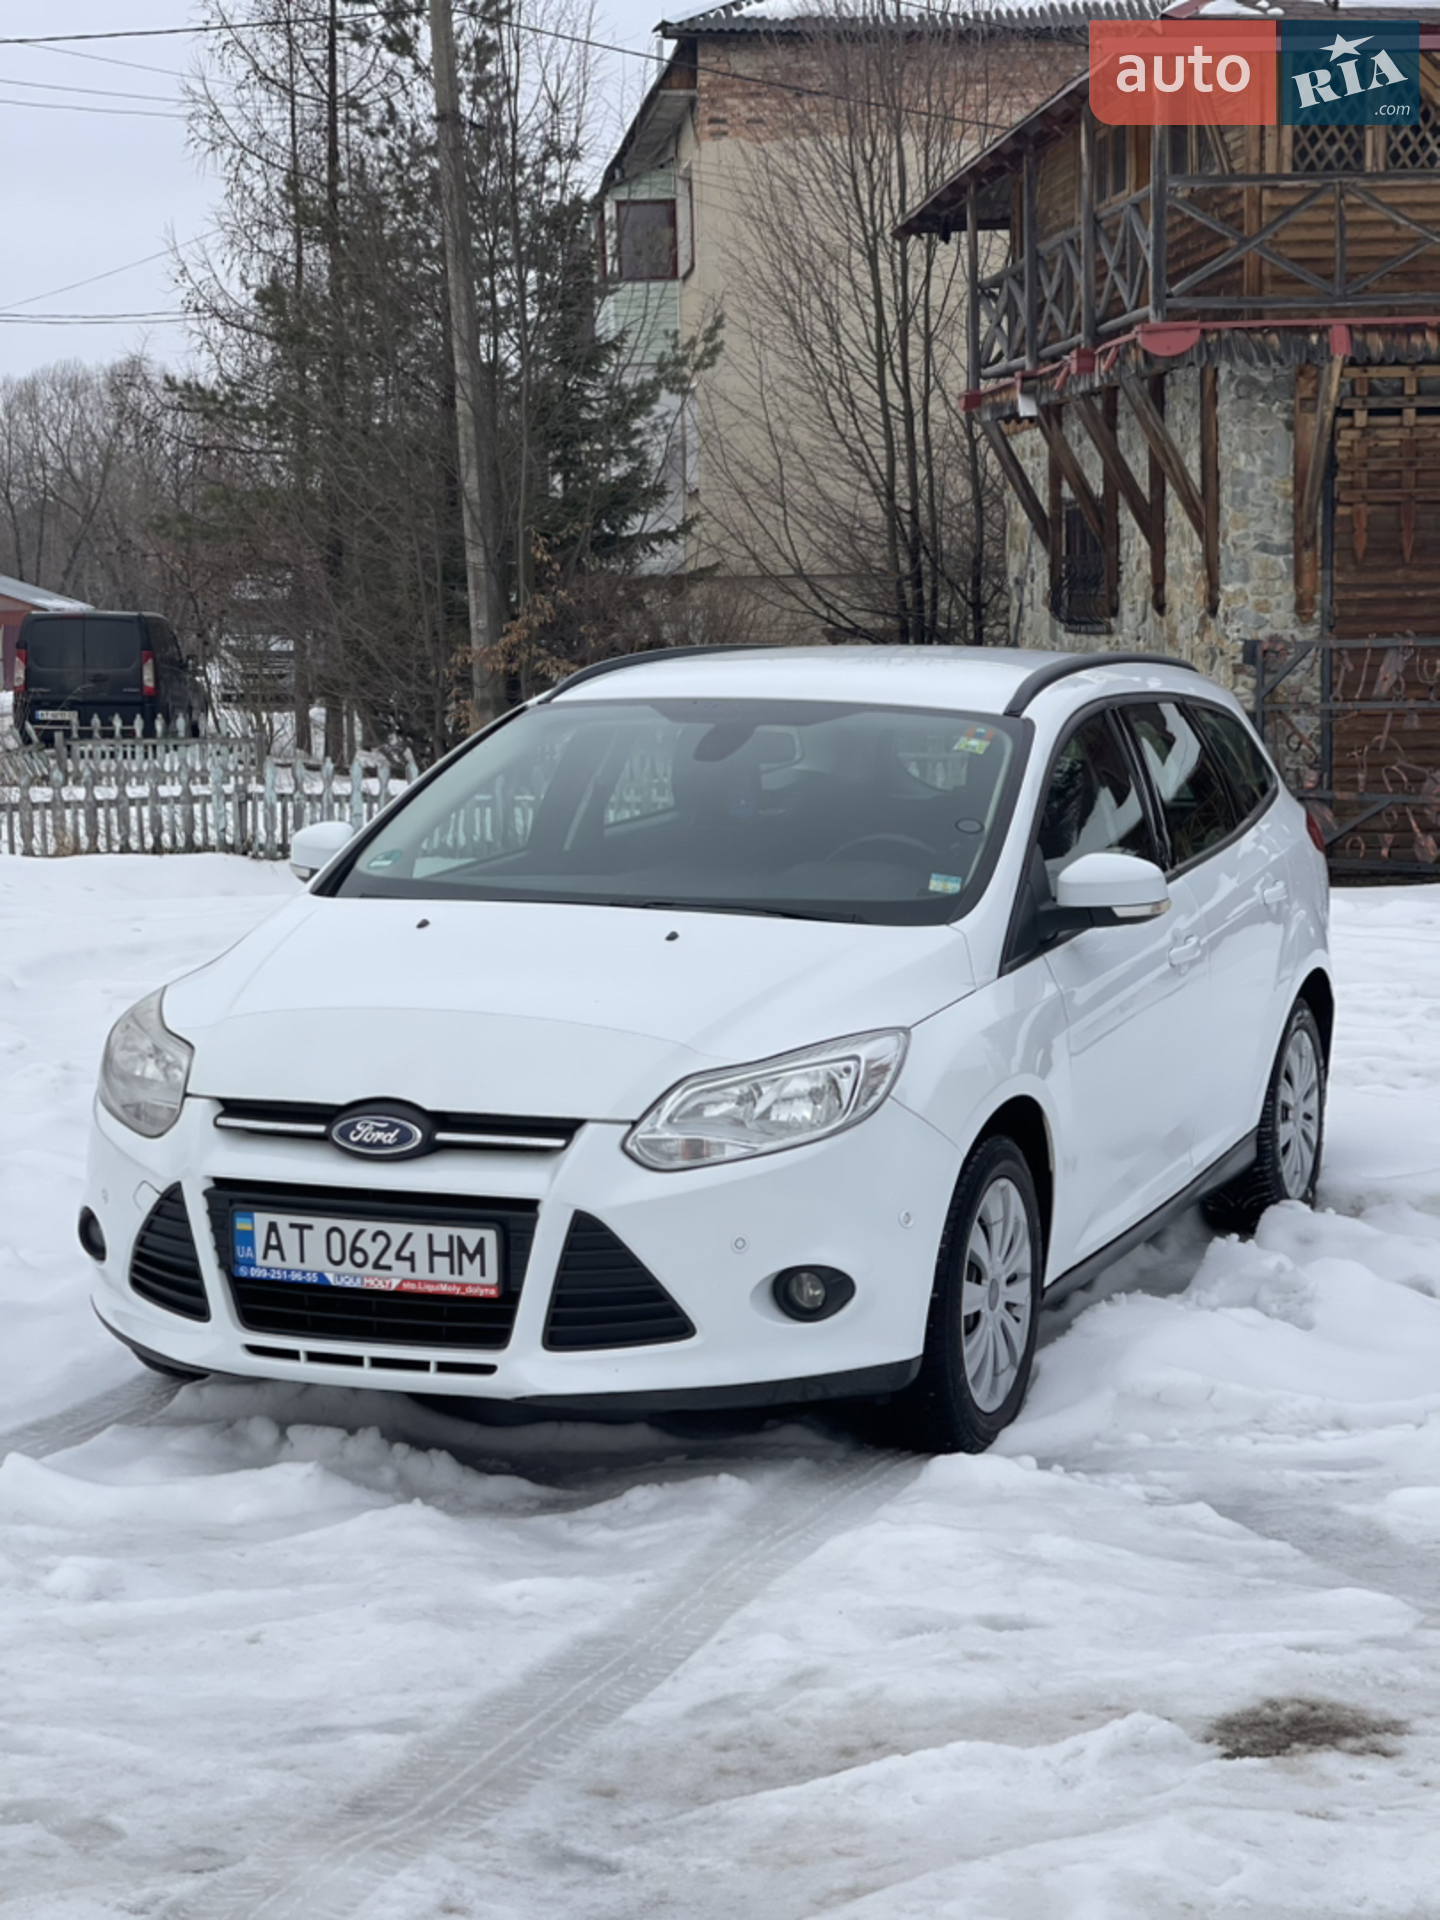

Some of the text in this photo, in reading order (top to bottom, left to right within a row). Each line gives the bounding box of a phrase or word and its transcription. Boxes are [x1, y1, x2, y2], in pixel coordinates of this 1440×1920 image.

[349, 1119, 400, 1145] Ford
[236, 1246, 254, 1260] UA
[261, 1221, 486, 1278] AT 0624 HM
